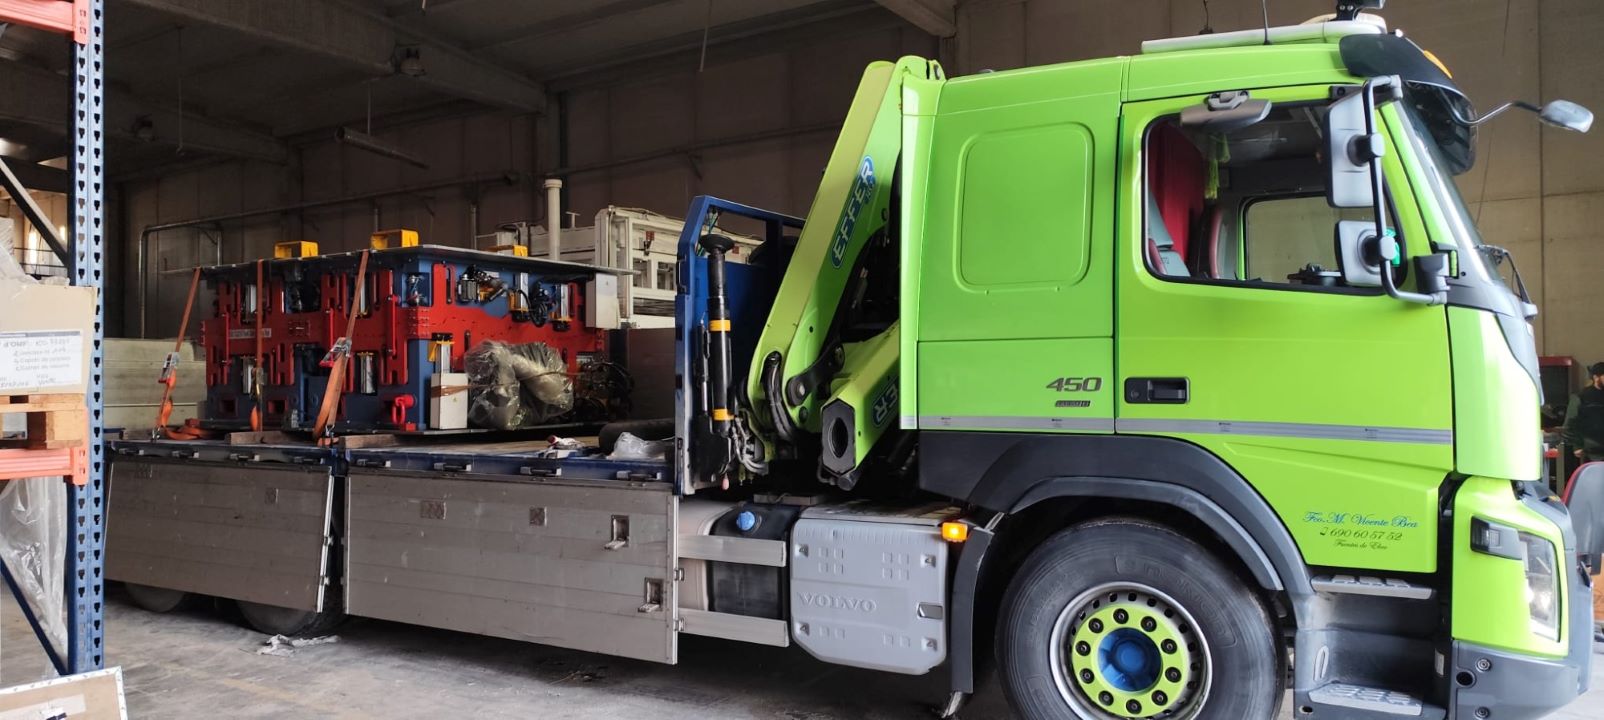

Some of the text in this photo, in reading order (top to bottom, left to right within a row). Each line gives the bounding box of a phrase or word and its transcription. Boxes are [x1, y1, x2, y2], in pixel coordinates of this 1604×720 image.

[832, 160, 874, 261] EFFER
[1046, 377, 1102, 392] 450
[1351, 513, 1389, 527] Vicente
[1391, 515, 1418, 528] Bea
[1330, 528, 1403, 541] 690 60 57 52
[797, 591, 877, 612] VOLVO
